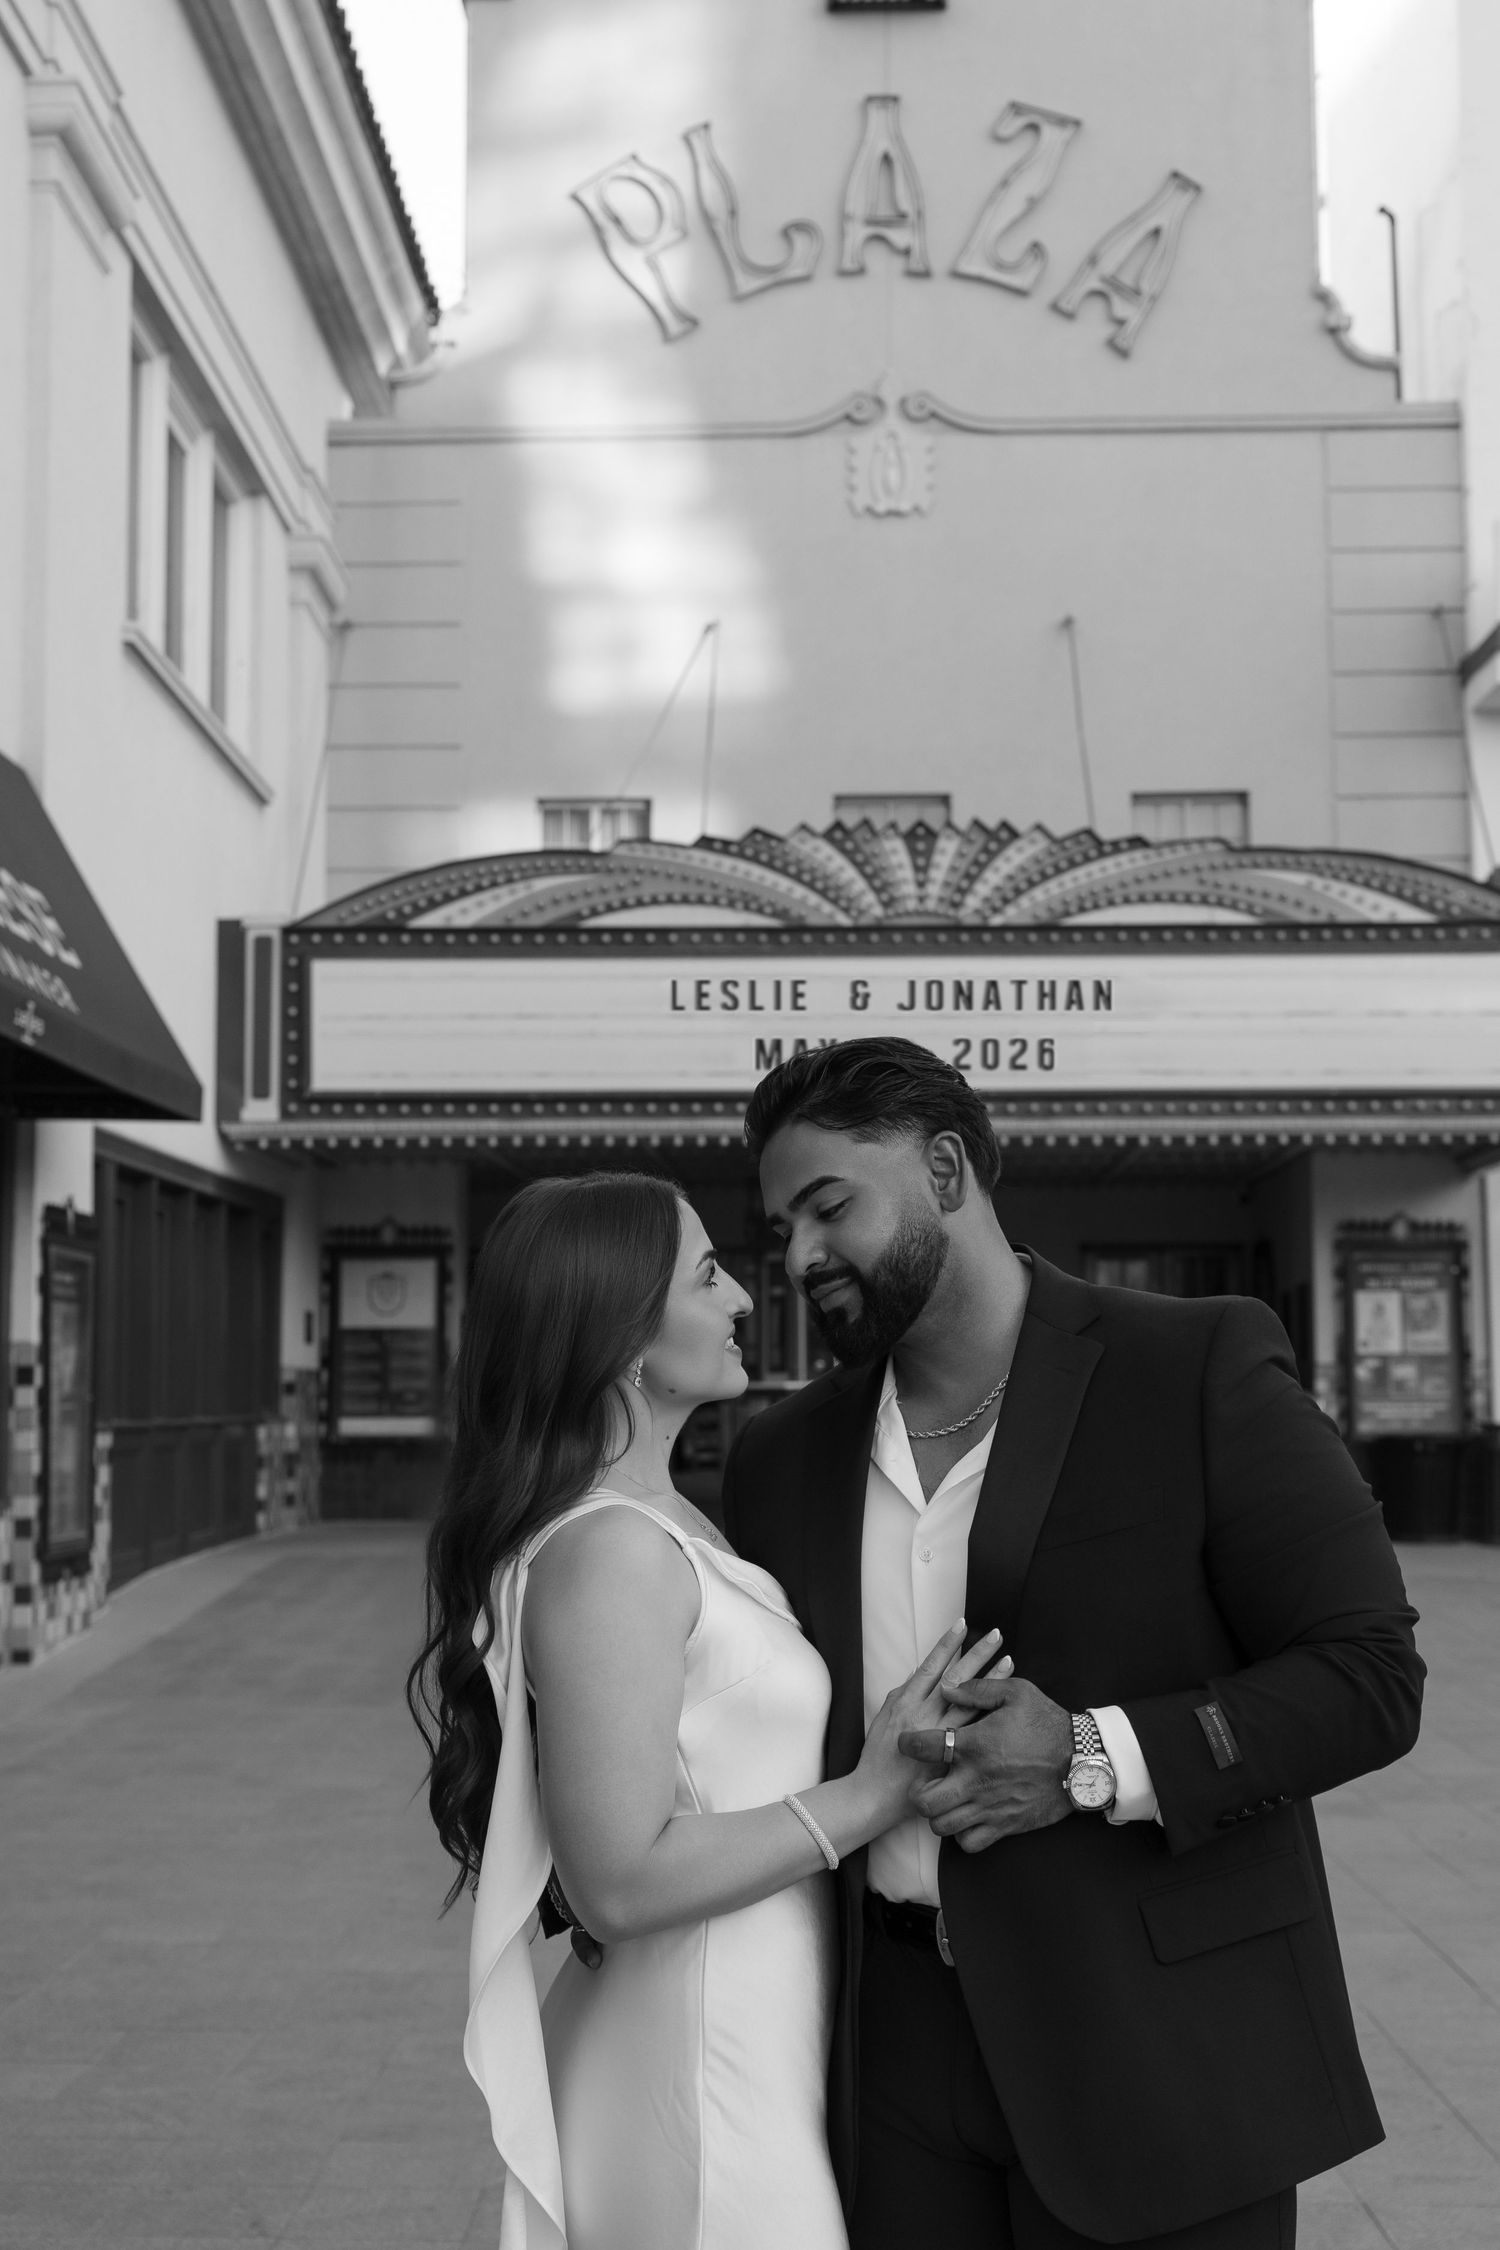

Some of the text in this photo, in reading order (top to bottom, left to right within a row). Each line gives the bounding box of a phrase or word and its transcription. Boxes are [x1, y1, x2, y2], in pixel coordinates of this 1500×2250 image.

[568, 94, 1204, 360] PLAZA
[670, 979, 1114, 1012] LESLIE & JONATHAN
[755, 1037, 1056, 1072] MA 2026
